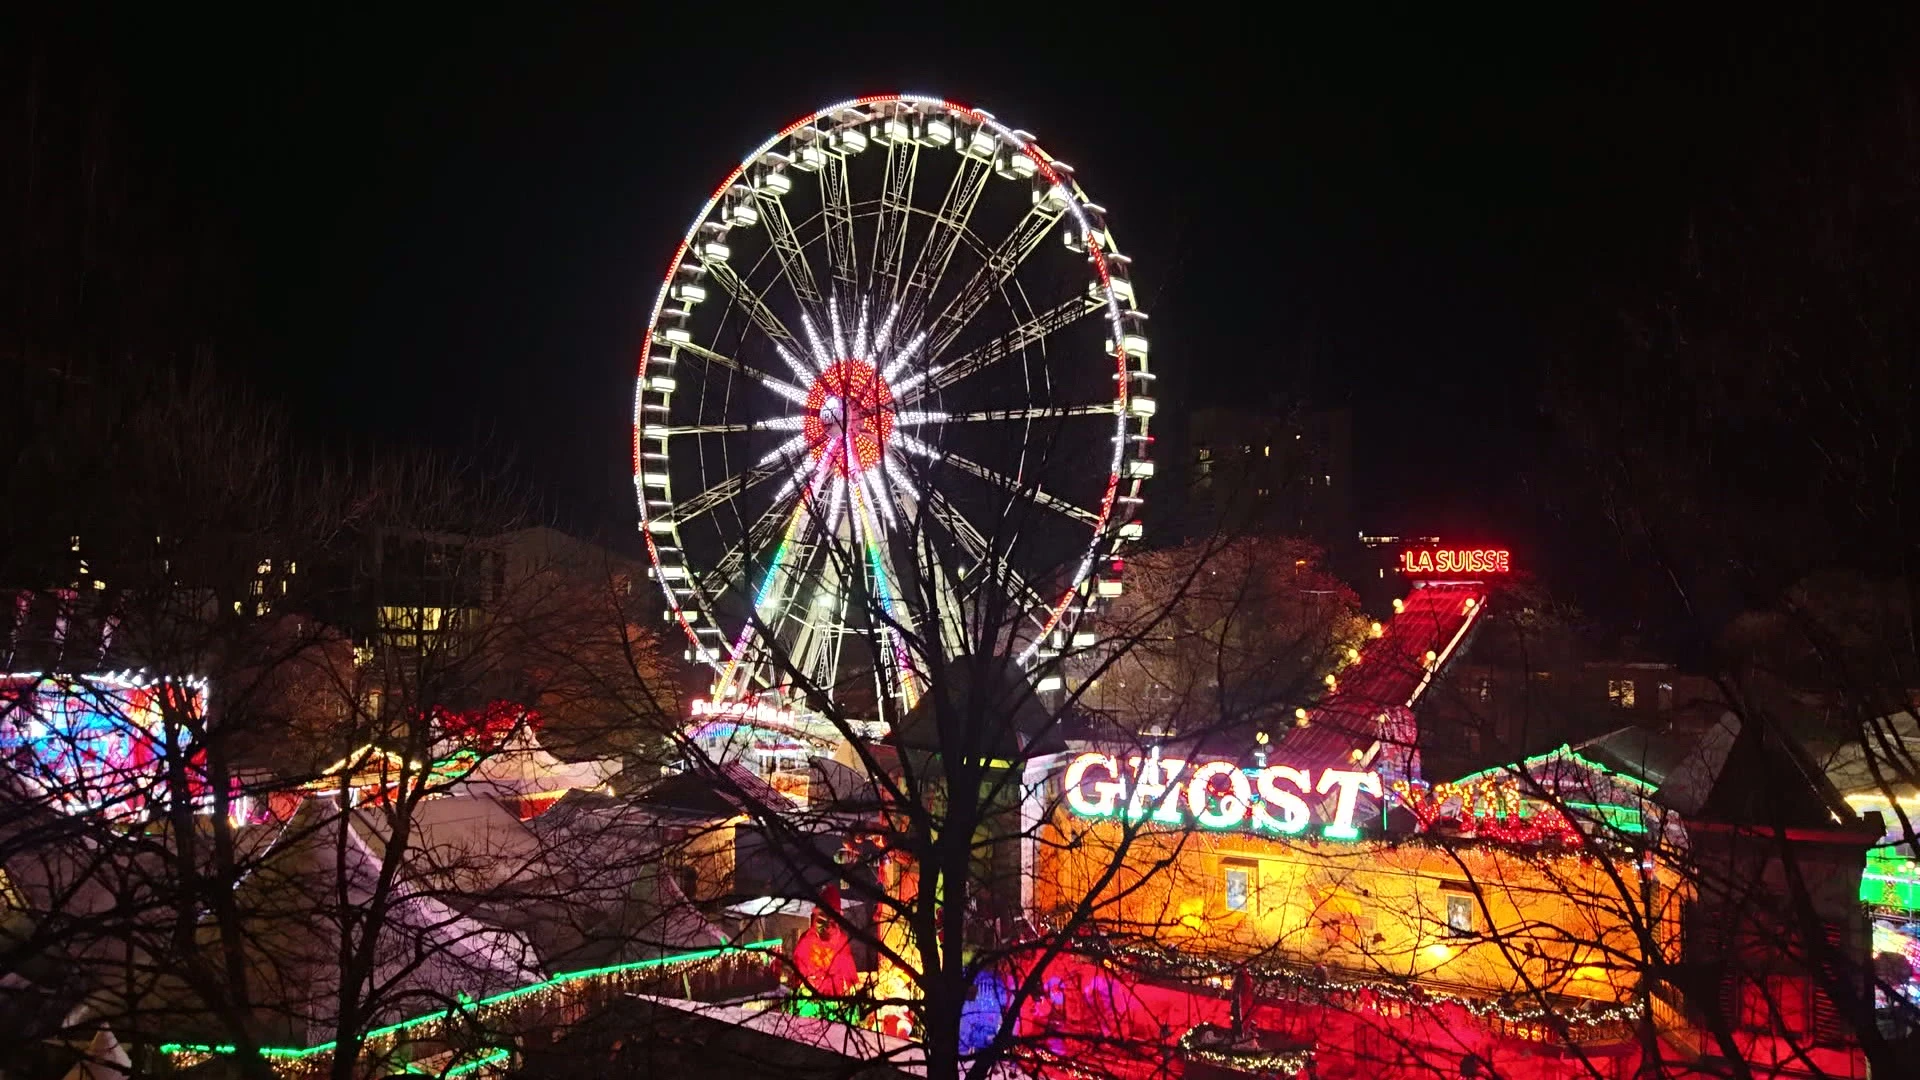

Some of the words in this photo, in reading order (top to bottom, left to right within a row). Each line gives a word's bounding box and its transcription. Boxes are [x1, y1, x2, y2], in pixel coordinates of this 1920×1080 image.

[1406, 550, 1434, 572] LA
[1435, 550, 1510, 572] SUISSE
[1064, 752, 1384, 839] GHOST
